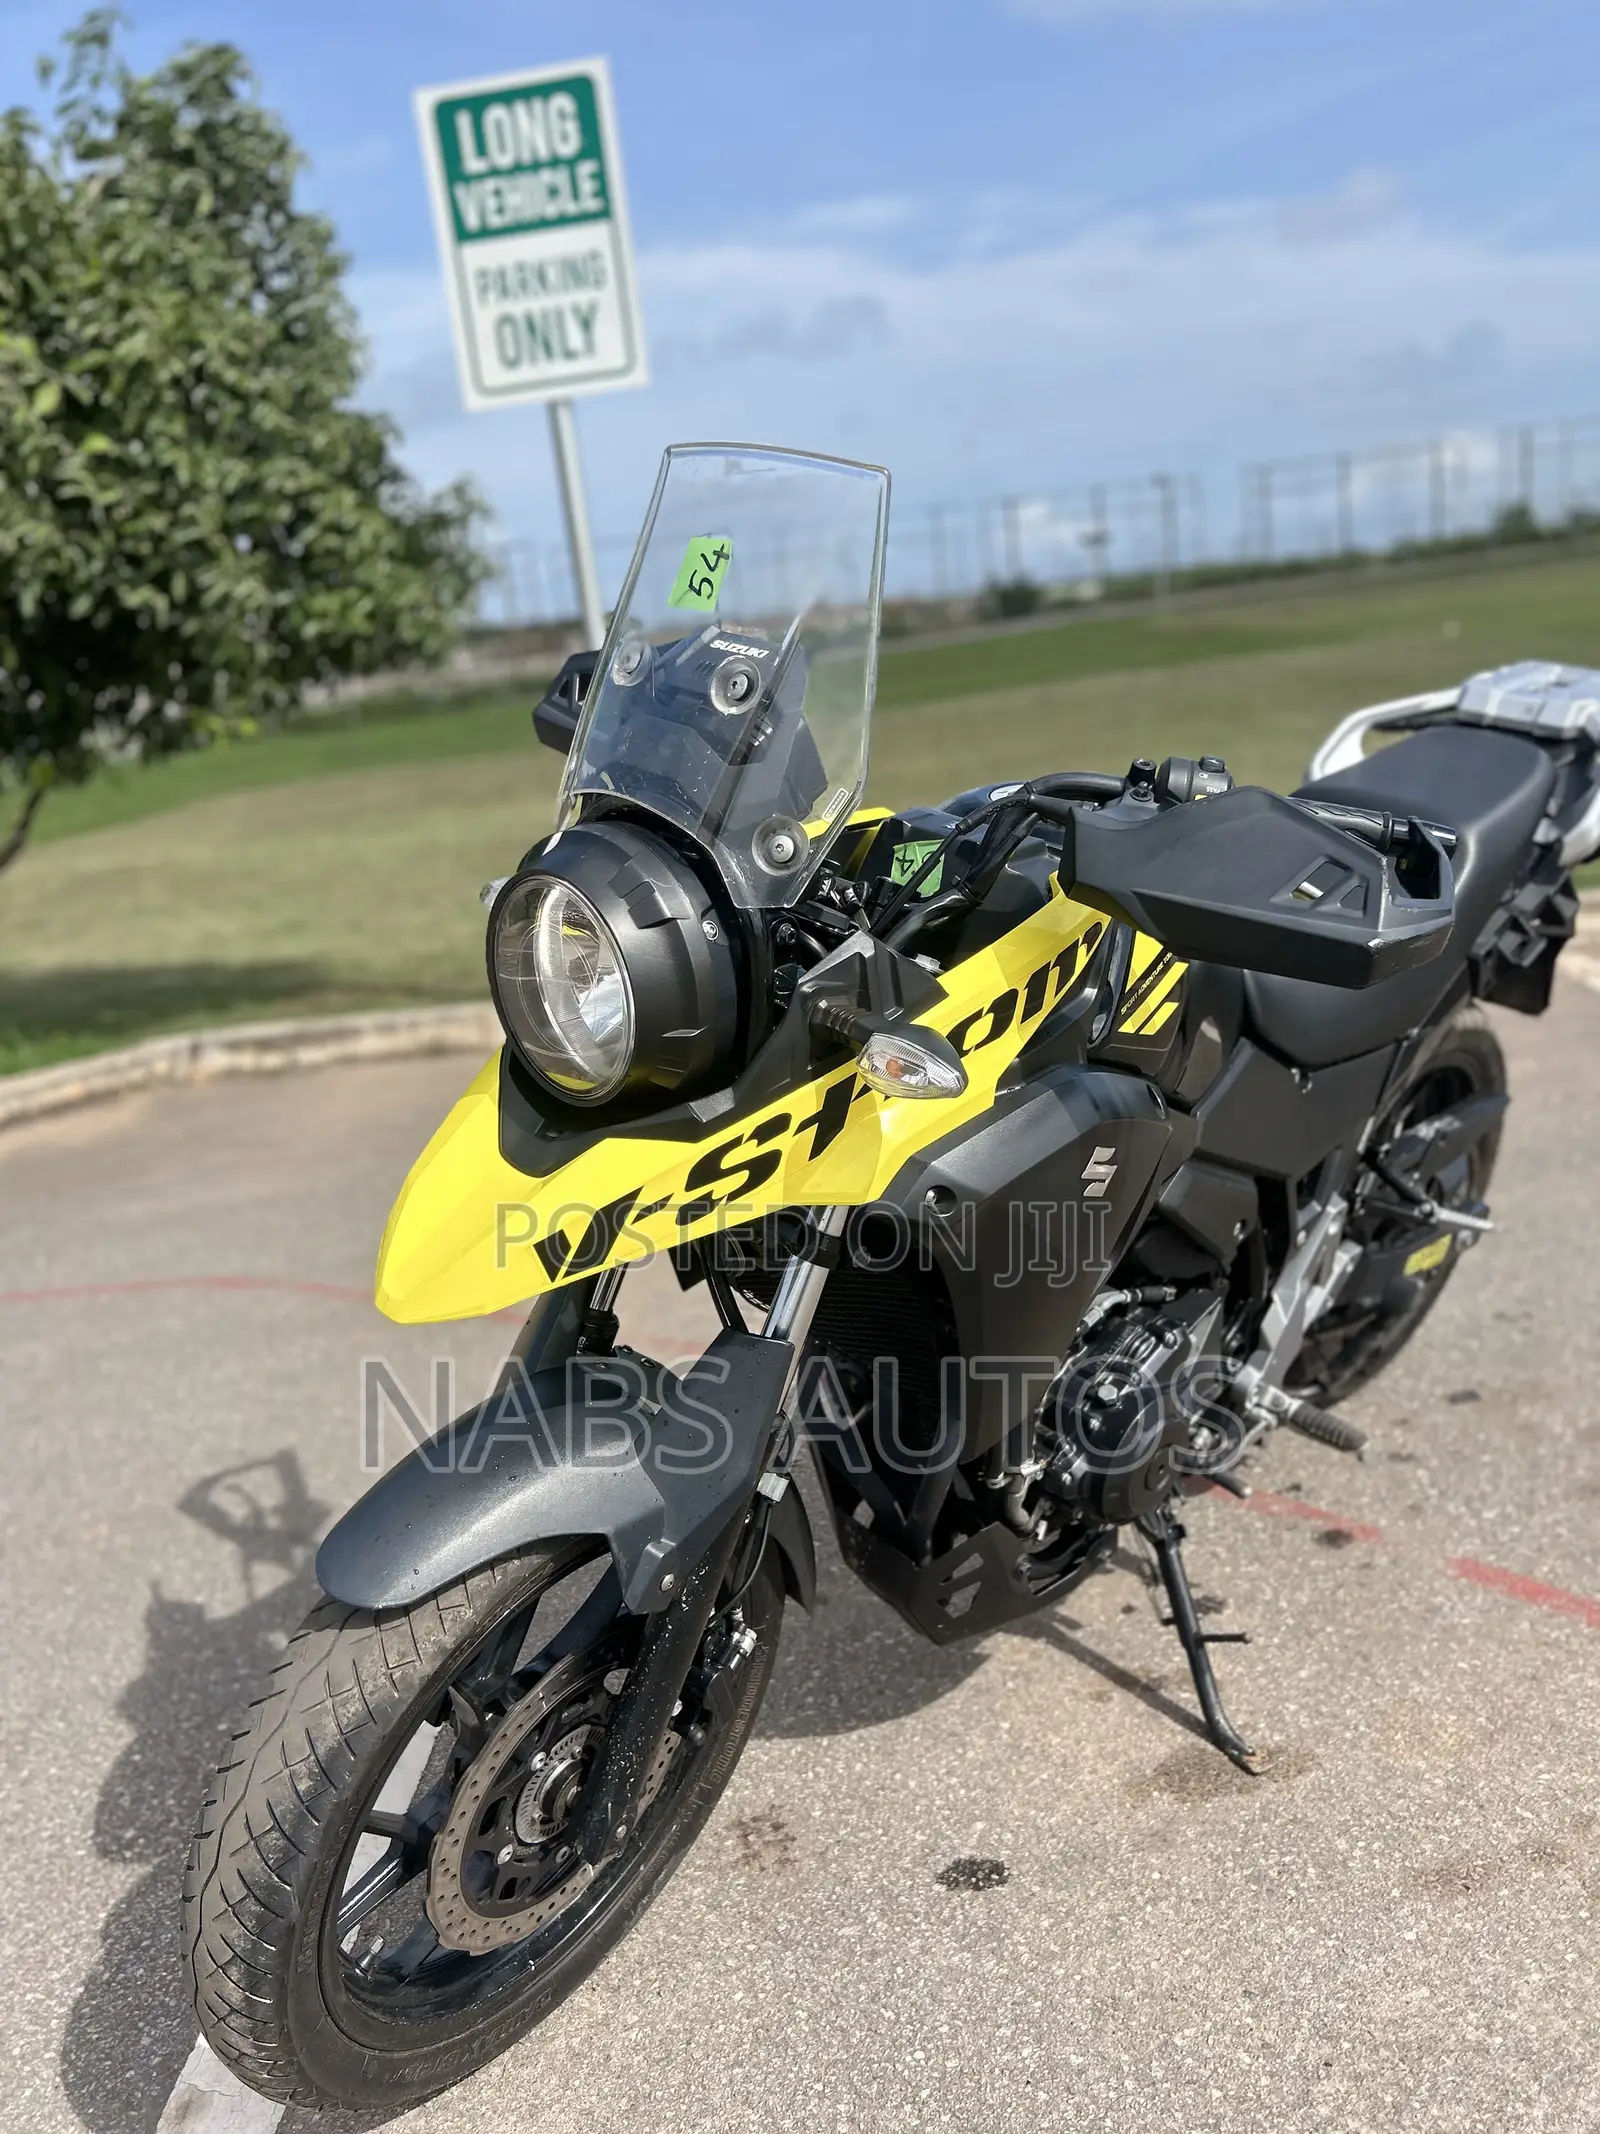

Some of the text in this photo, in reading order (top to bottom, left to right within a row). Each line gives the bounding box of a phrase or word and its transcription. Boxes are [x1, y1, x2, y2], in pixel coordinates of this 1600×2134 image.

[455, 92, 582, 174] LONG
[454, 159, 604, 232] VEHICLE
[475, 251, 606, 305] PARKING
[494, 301, 600, 370] ONLY
[688, 543, 730, 600] 54
[709, 639, 770, 659] SUZUKI
[1120, 993, 1138, 1015] SPORT
[1137, 961, 1164, 996] ADVENTURE
